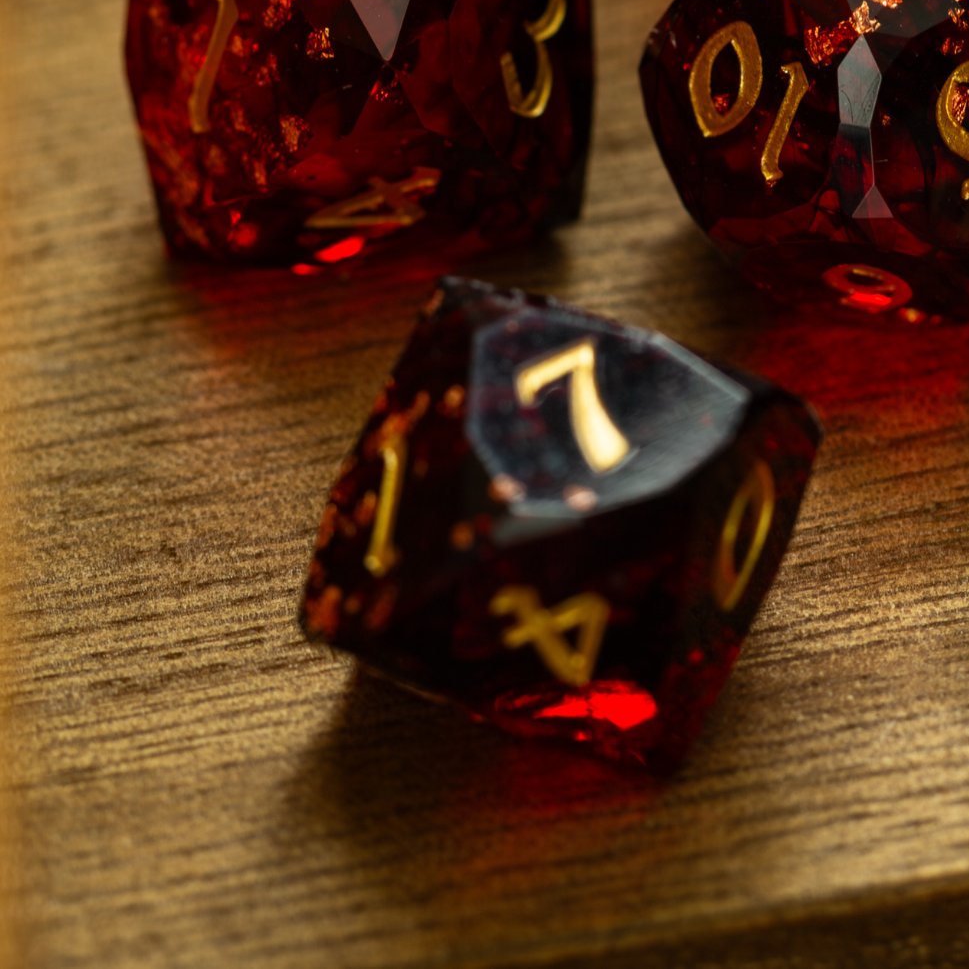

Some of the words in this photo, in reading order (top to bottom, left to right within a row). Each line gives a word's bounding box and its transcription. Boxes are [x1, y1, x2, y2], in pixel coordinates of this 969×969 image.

[689, 20, 809, 183] 10
[514, 338, 630, 474] 7
[713, 460, 773, 613] 0
[489, 584, 610, 686] 4
